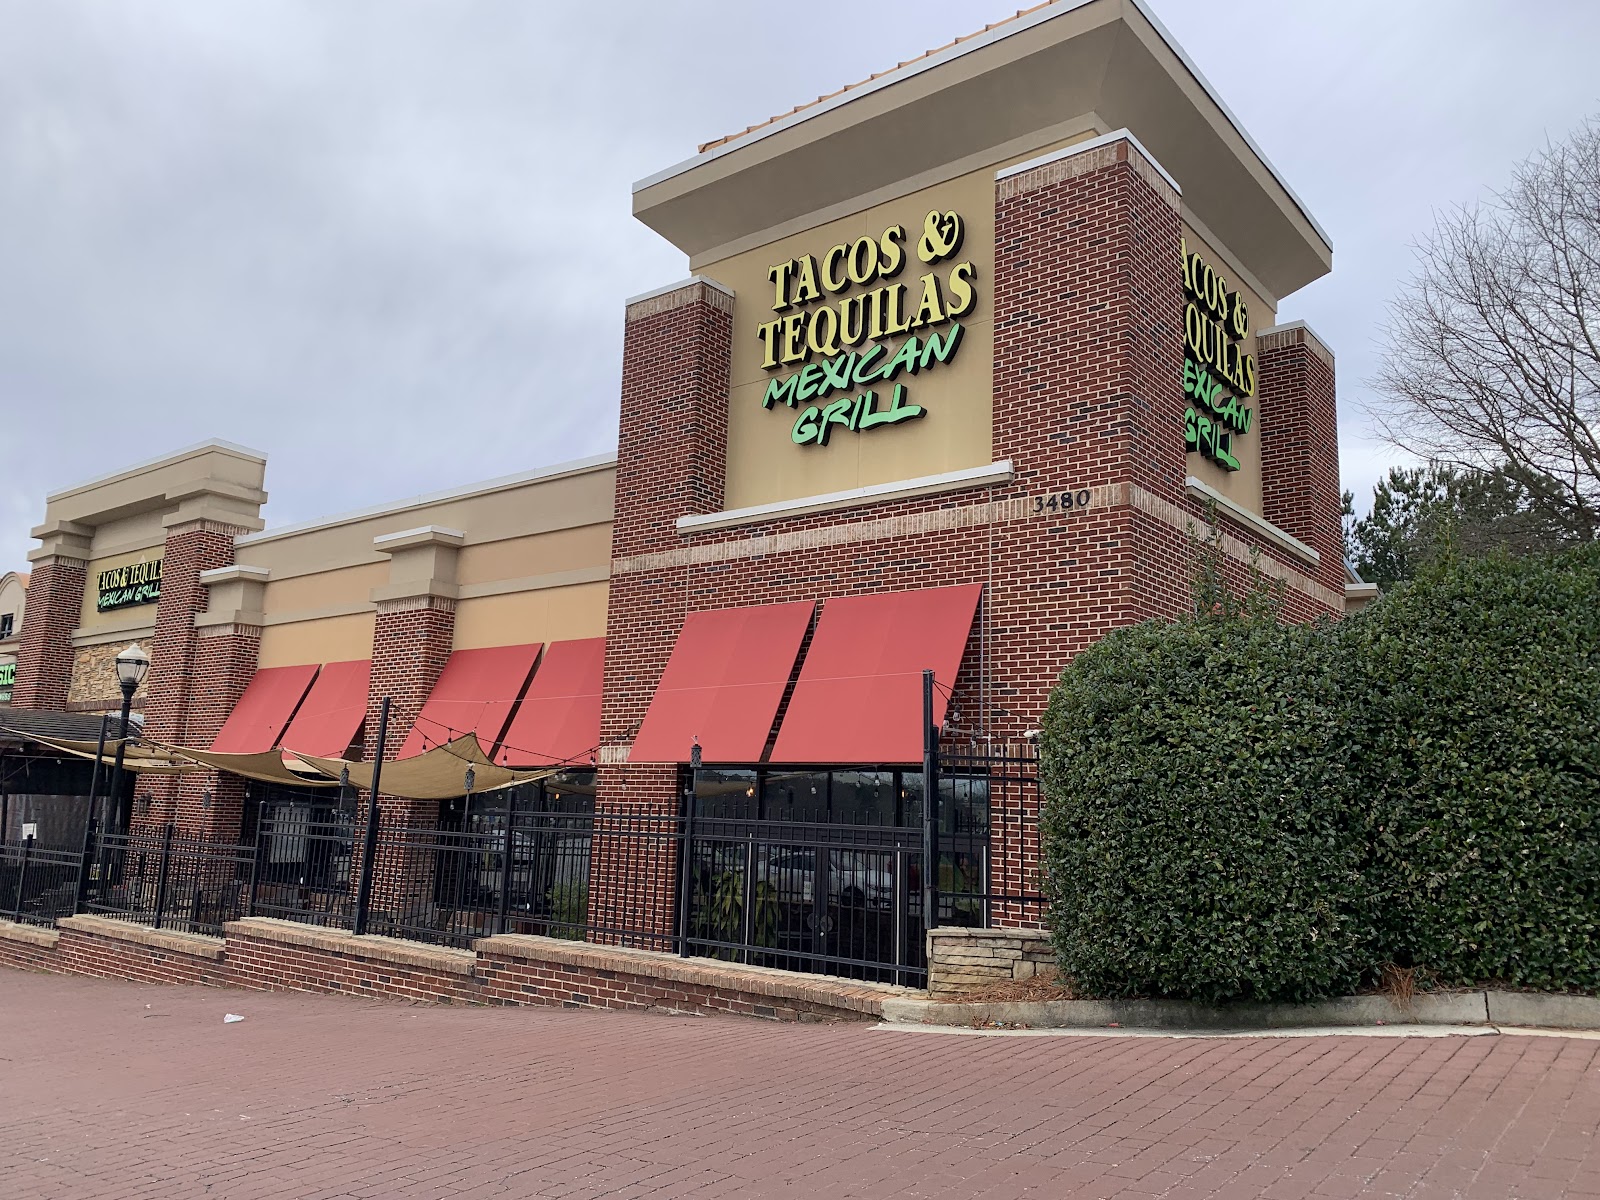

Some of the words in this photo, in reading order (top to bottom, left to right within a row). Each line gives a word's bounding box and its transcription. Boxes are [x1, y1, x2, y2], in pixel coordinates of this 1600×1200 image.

[768, 224, 905, 312] TACOS
[917, 209, 963, 264] &
[757, 261, 976, 371] TEQUILAS
[1232, 290, 1249, 340] &
[762, 322, 964, 409] MEXICAN
[1183, 302, 1255, 398] QUILAS
[791, 382, 926, 445] GRILL
[1184, 406, 1241, 472] GRILL
[1033, 489, 1091, 513] 3480
[97, 569, 121, 591] TACOS
[120, 567, 129, 588] &
[98, 587, 135, 608] MEXICAN
[135, 582, 161, 602] GRILL
